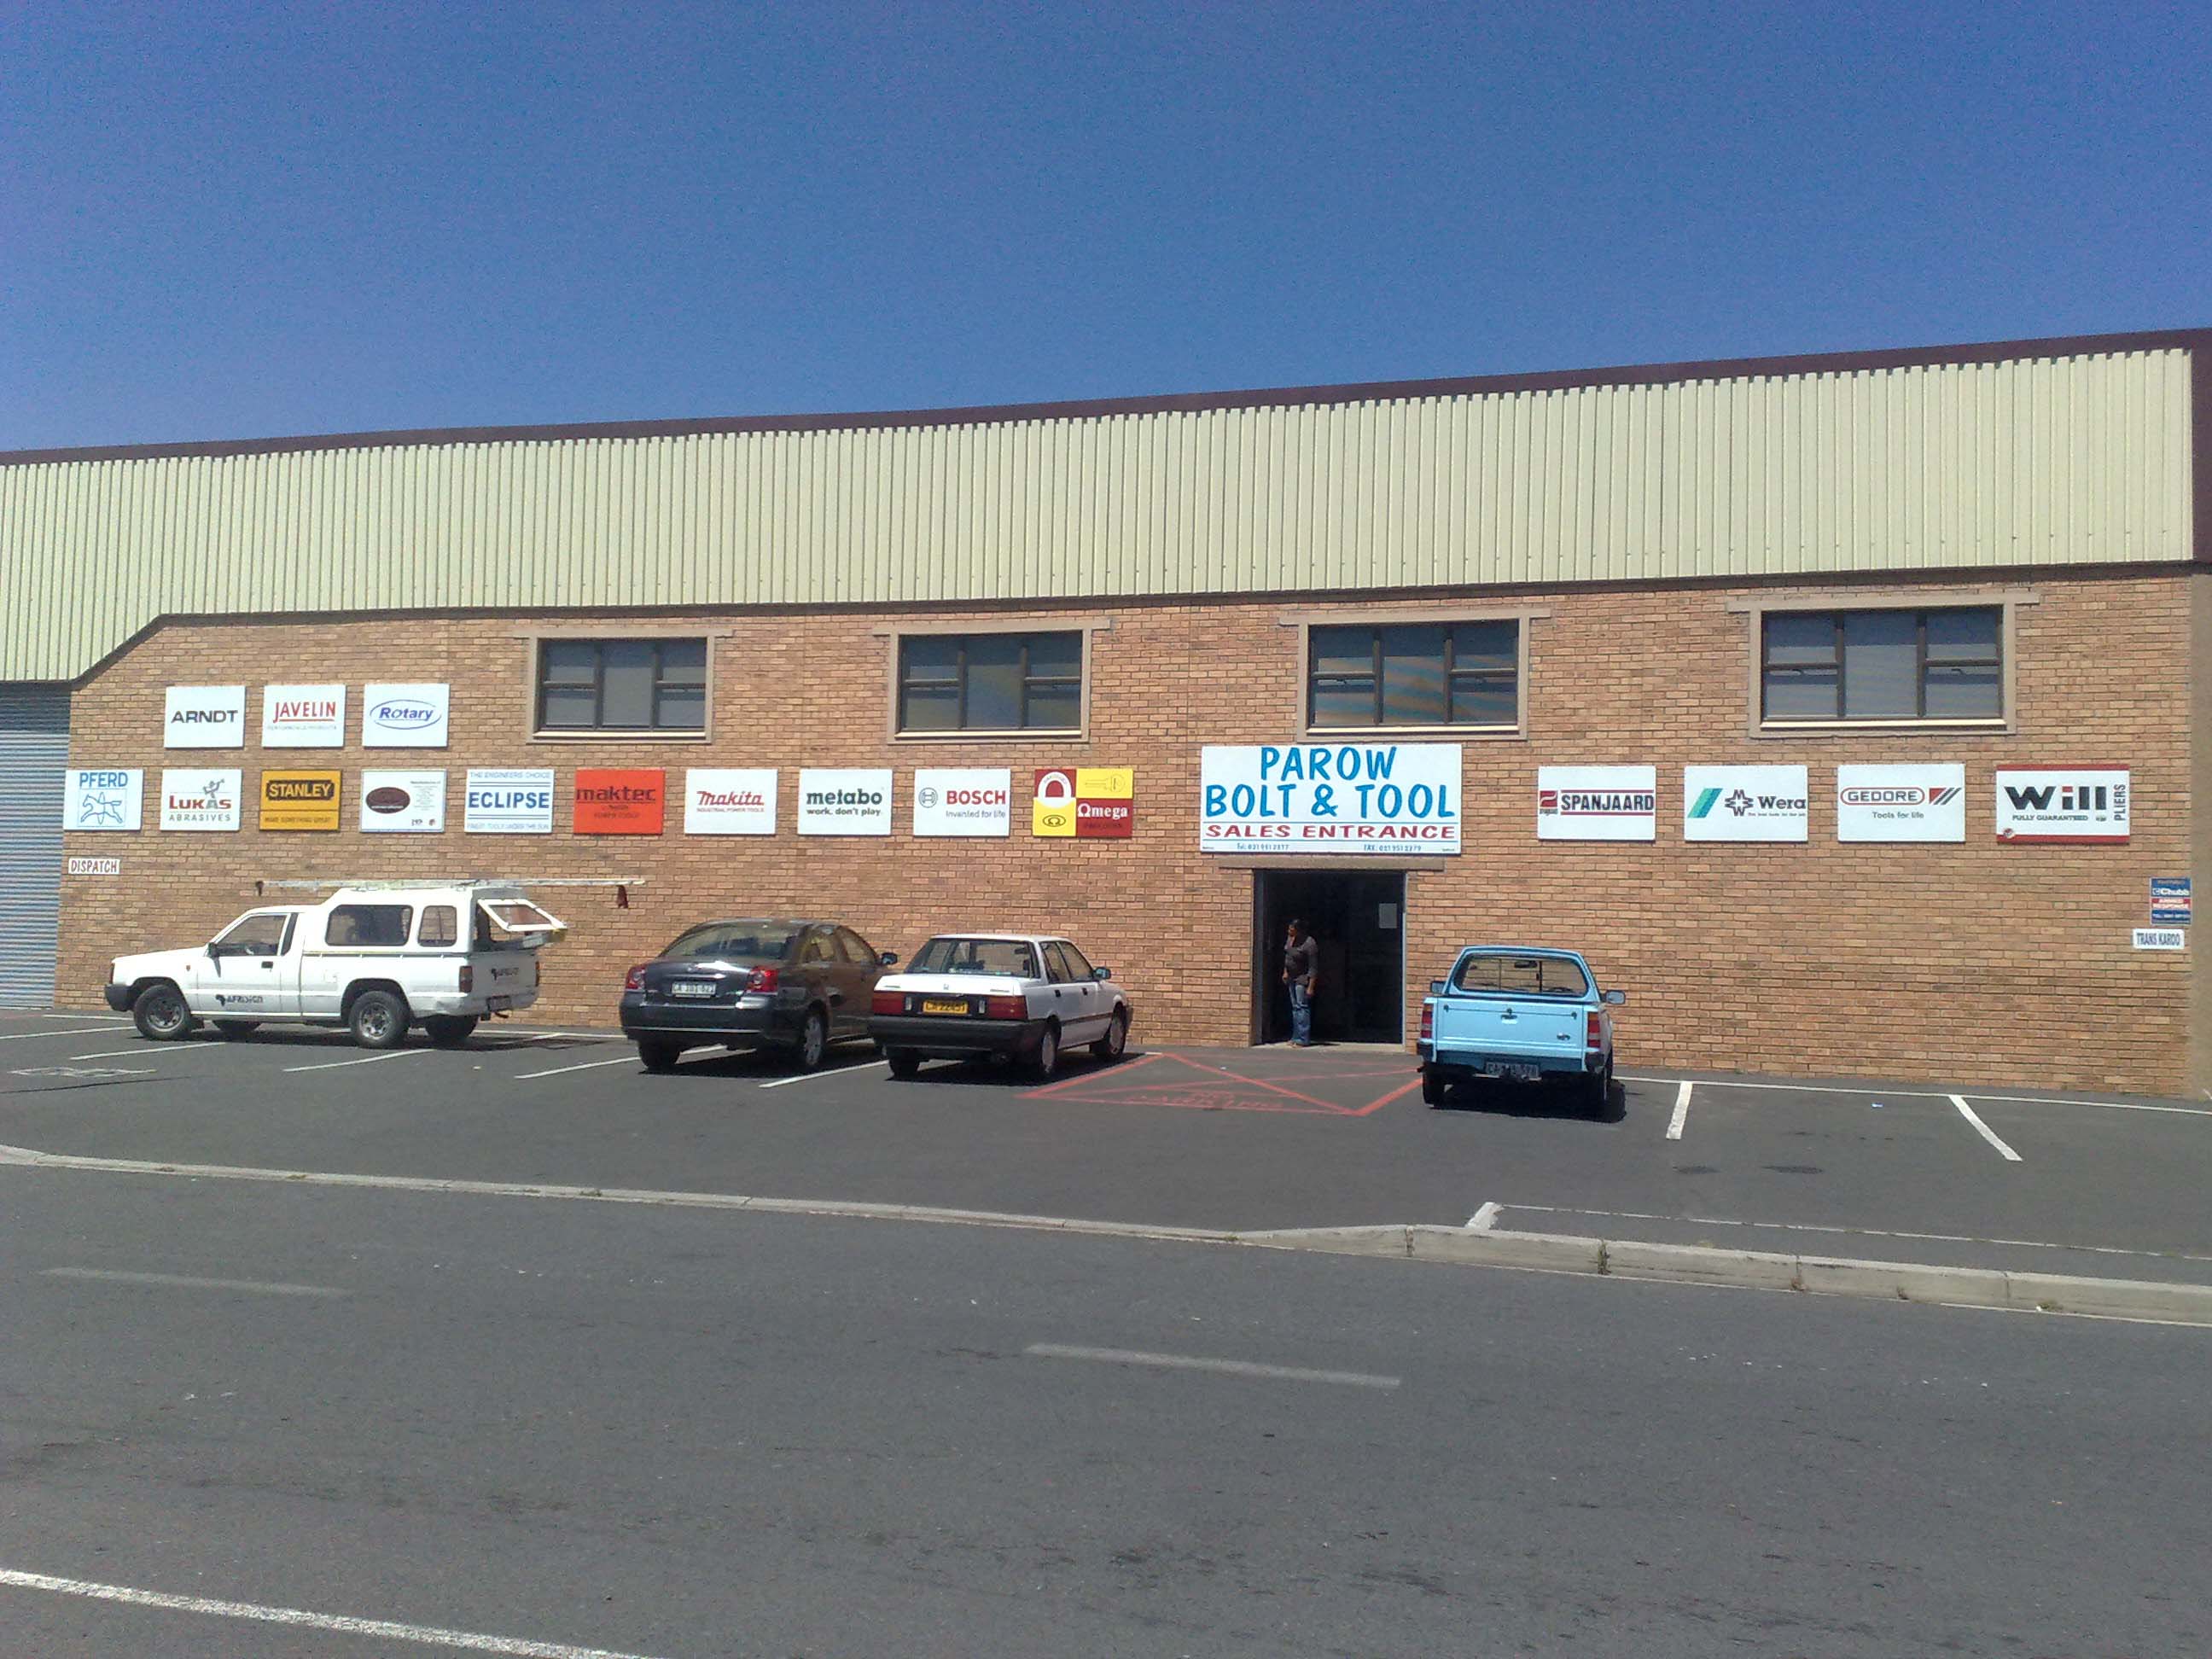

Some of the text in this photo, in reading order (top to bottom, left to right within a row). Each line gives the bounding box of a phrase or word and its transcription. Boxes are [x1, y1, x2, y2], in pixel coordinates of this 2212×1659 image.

[171, 709, 238, 724] ARNDT
[272, 701, 336, 723] JAVELIN
[378, 707, 434, 721] Rotary
[1260, 746, 1397, 781] PAROW
[79, 771, 128, 788] PFERD
[268, 783, 332, 798] STANLEY
[576, 785, 656, 800] maktec
[696, 790, 765, 806] Makita
[806, 788, 882, 805] metabo
[946, 790, 1006, 805] BOSCH
[1848, 790, 1918, 801] GEDORE
[2003, 785, 2107, 810] Will
[468, 791, 550, 809] ECLIPSE
[1205, 783, 1455, 818] BOLT & TOOL
[1560, 795, 1654, 810] SPANJAARD
[1757, 795, 1807, 809] Wera
[2113, 783, 2126, 821] PLIERS
[168, 813, 231, 822] ABRASIVES
[946, 810, 980, 818] Invented
[1205, 824, 1455, 839] SALES ENTRANCE
[70, 859, 118, 873] DISPATCH
[2136, 932, 2157, 946] TRANS
